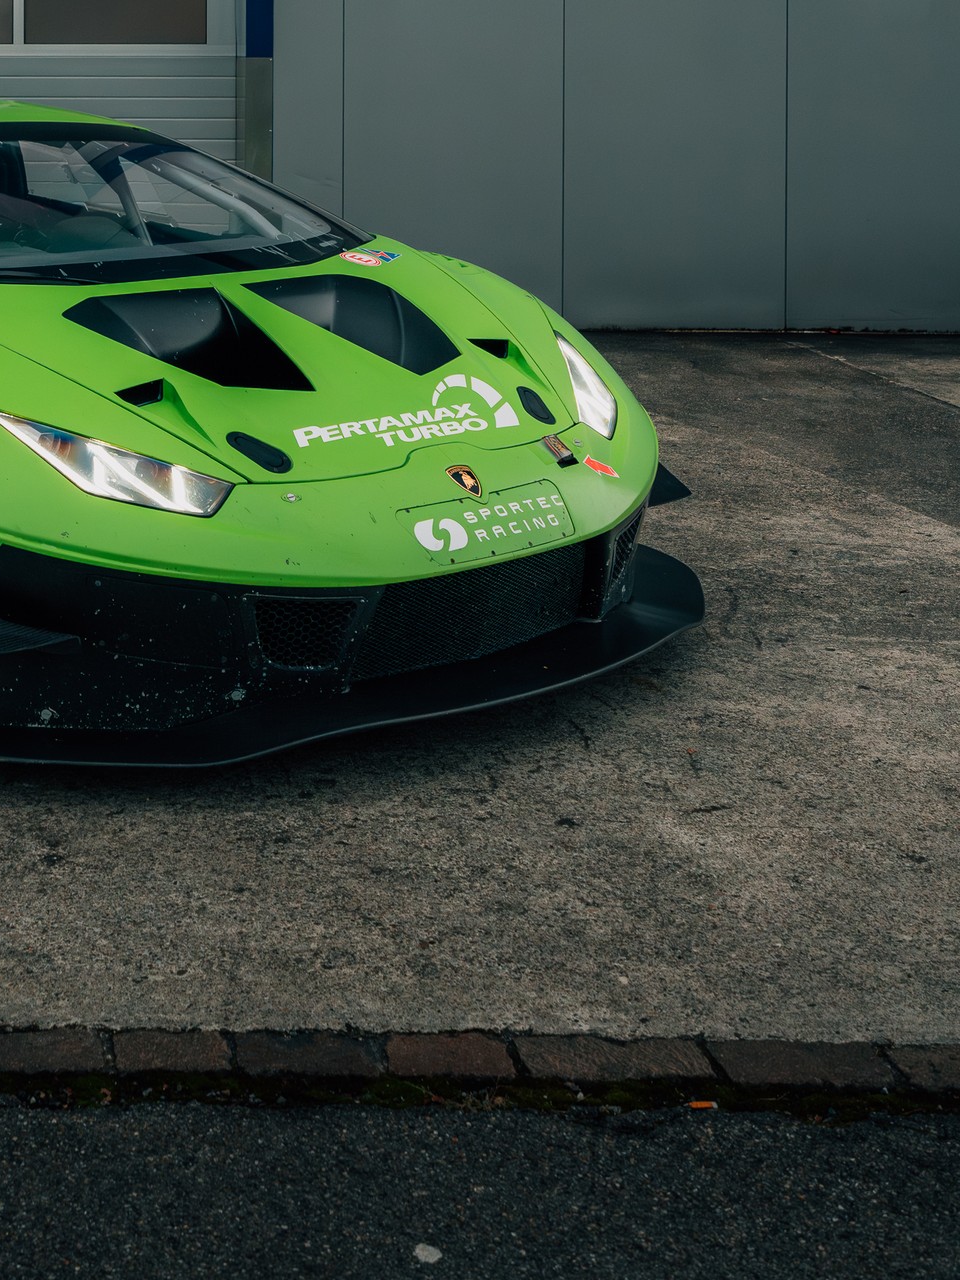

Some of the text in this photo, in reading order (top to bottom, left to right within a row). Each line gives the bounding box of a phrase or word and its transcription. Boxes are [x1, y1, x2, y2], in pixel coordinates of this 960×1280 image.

[292, 403, 479, 448] PERTAMAX
[375, 417, 489, 447] TURBO
[463, 495, 564, 524] SPORTEC
[474, 514, 559, 543] RACING
